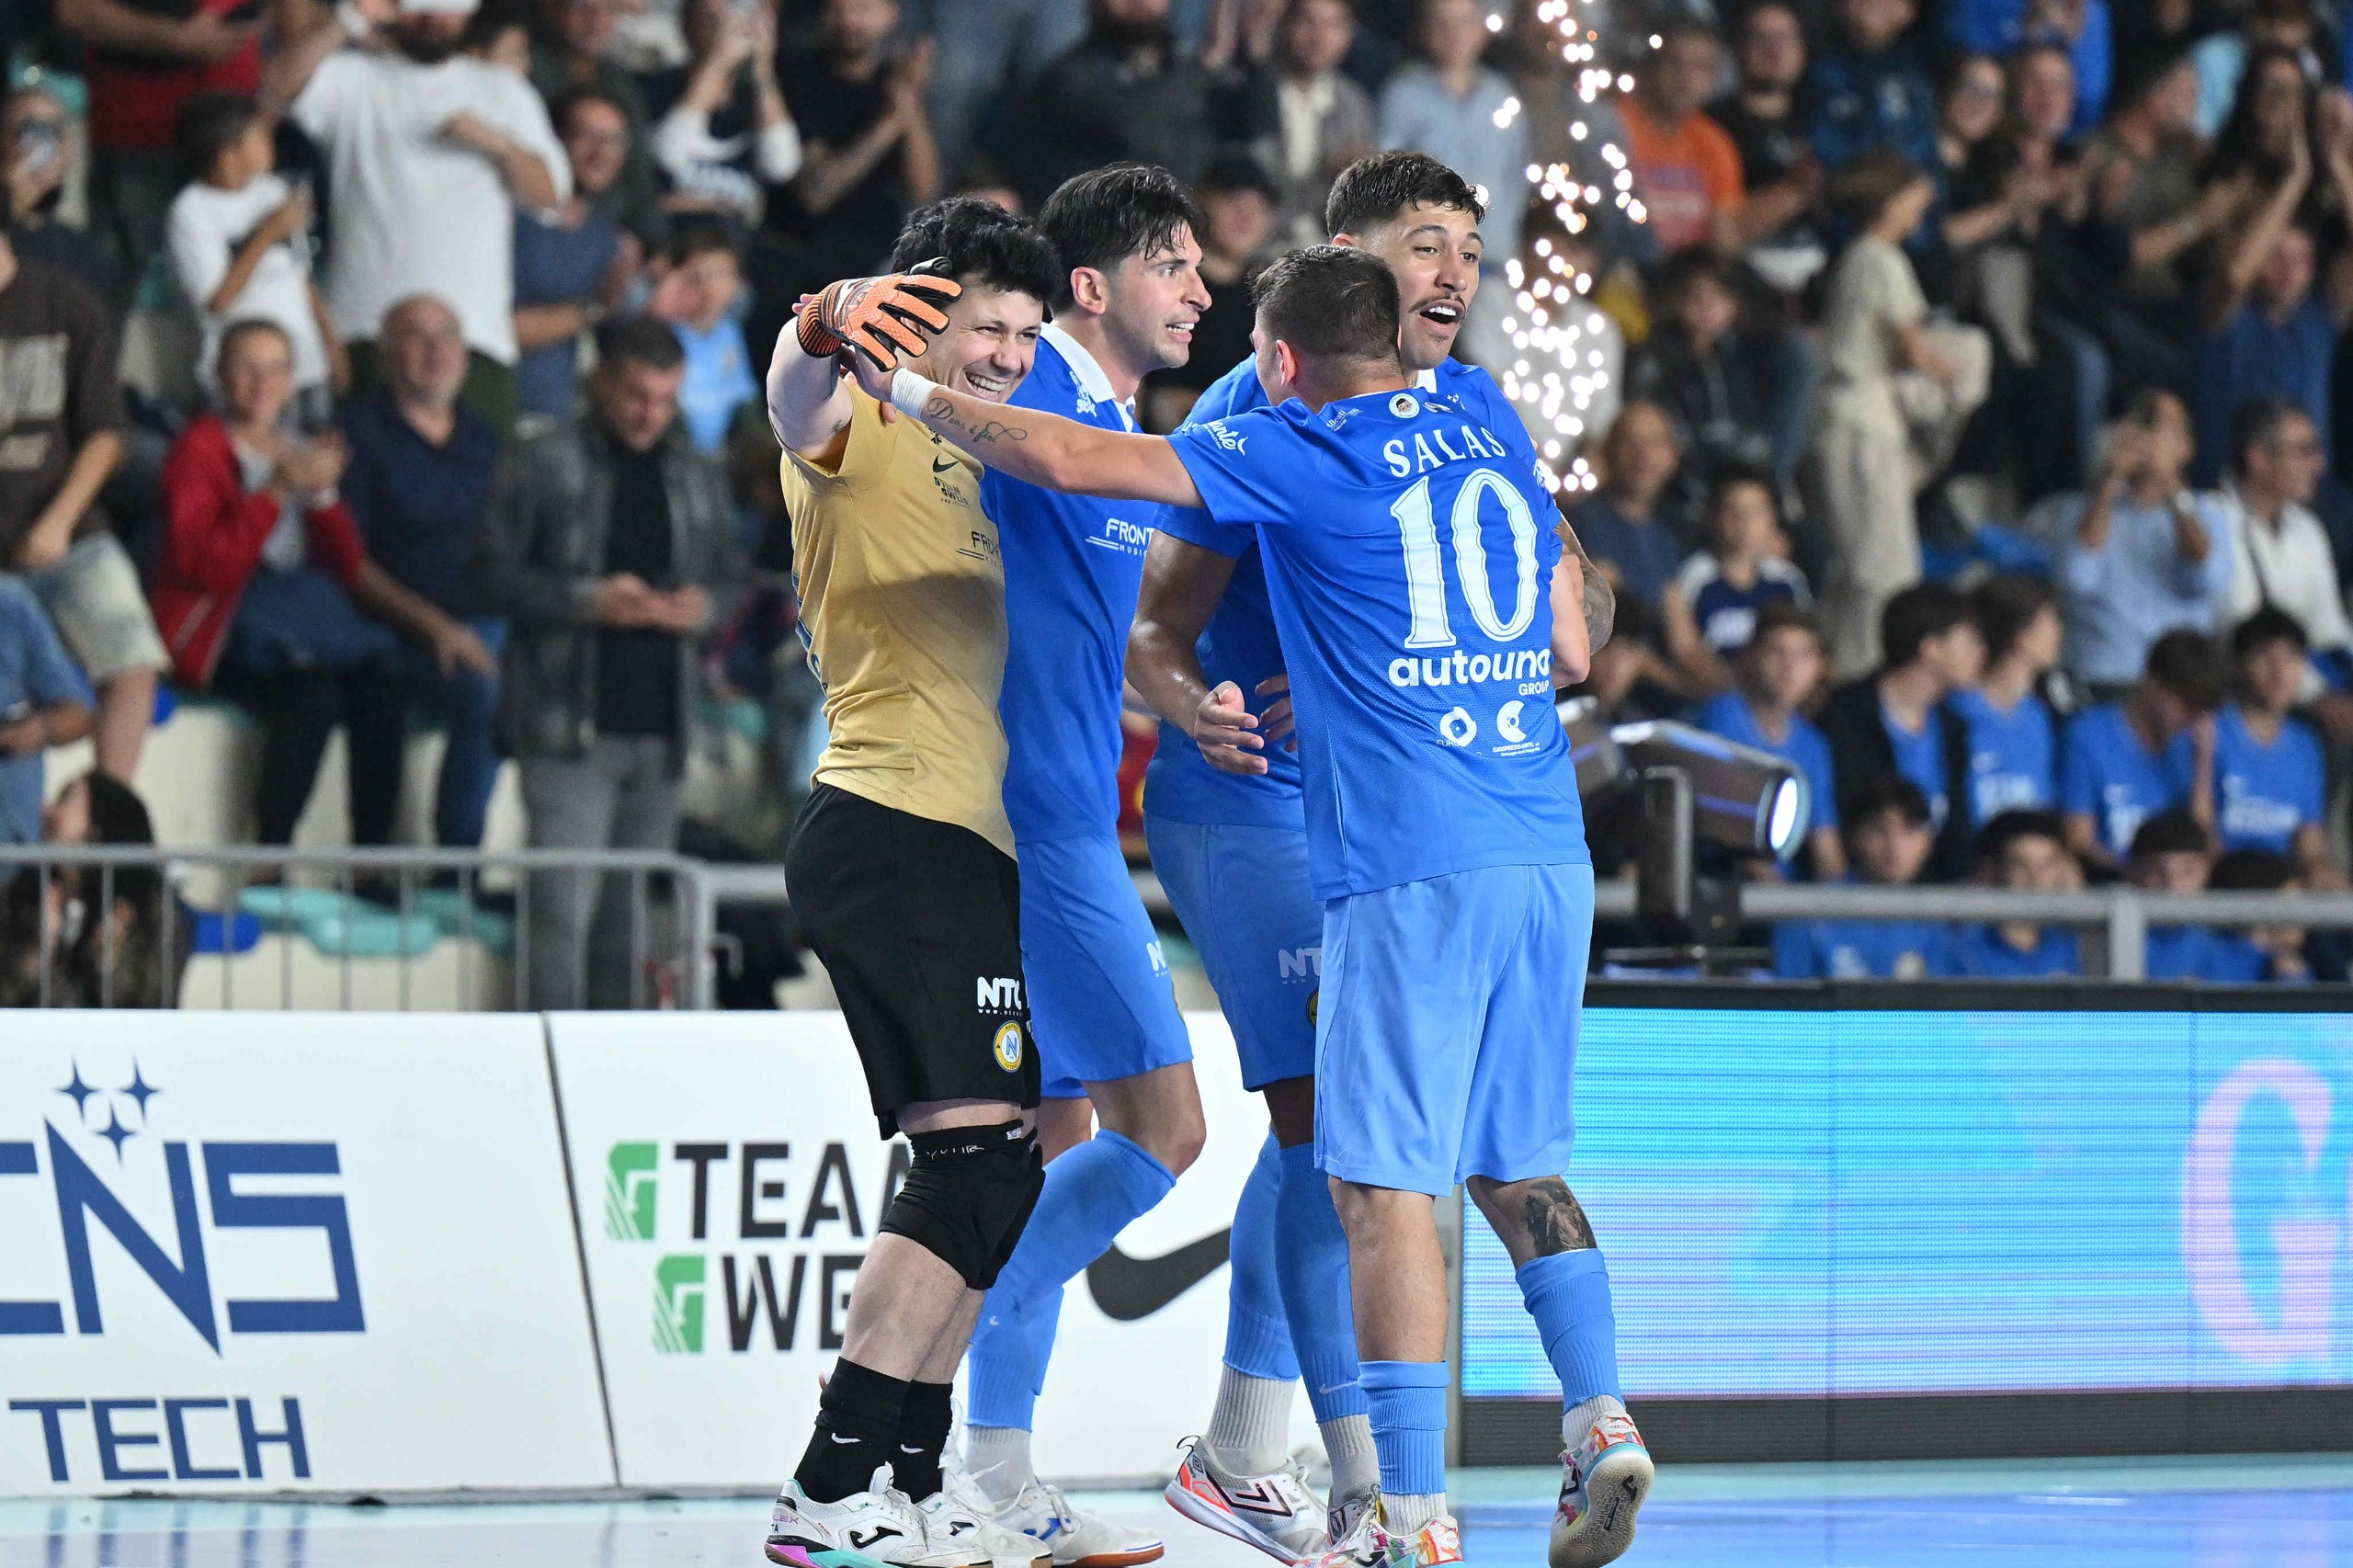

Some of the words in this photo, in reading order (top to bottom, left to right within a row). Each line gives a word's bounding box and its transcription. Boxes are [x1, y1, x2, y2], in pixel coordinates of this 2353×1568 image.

[1383, 425, 1506, 478] SALAS
[1106, 517, 1155, 546] FRONT
[1390, 468, 1540, 649] 10
[1388, 648, 1551, 687] autouno
[1518, 680, 1550, 696] GROUP
[8, 1396, 312, 1483] TECH
